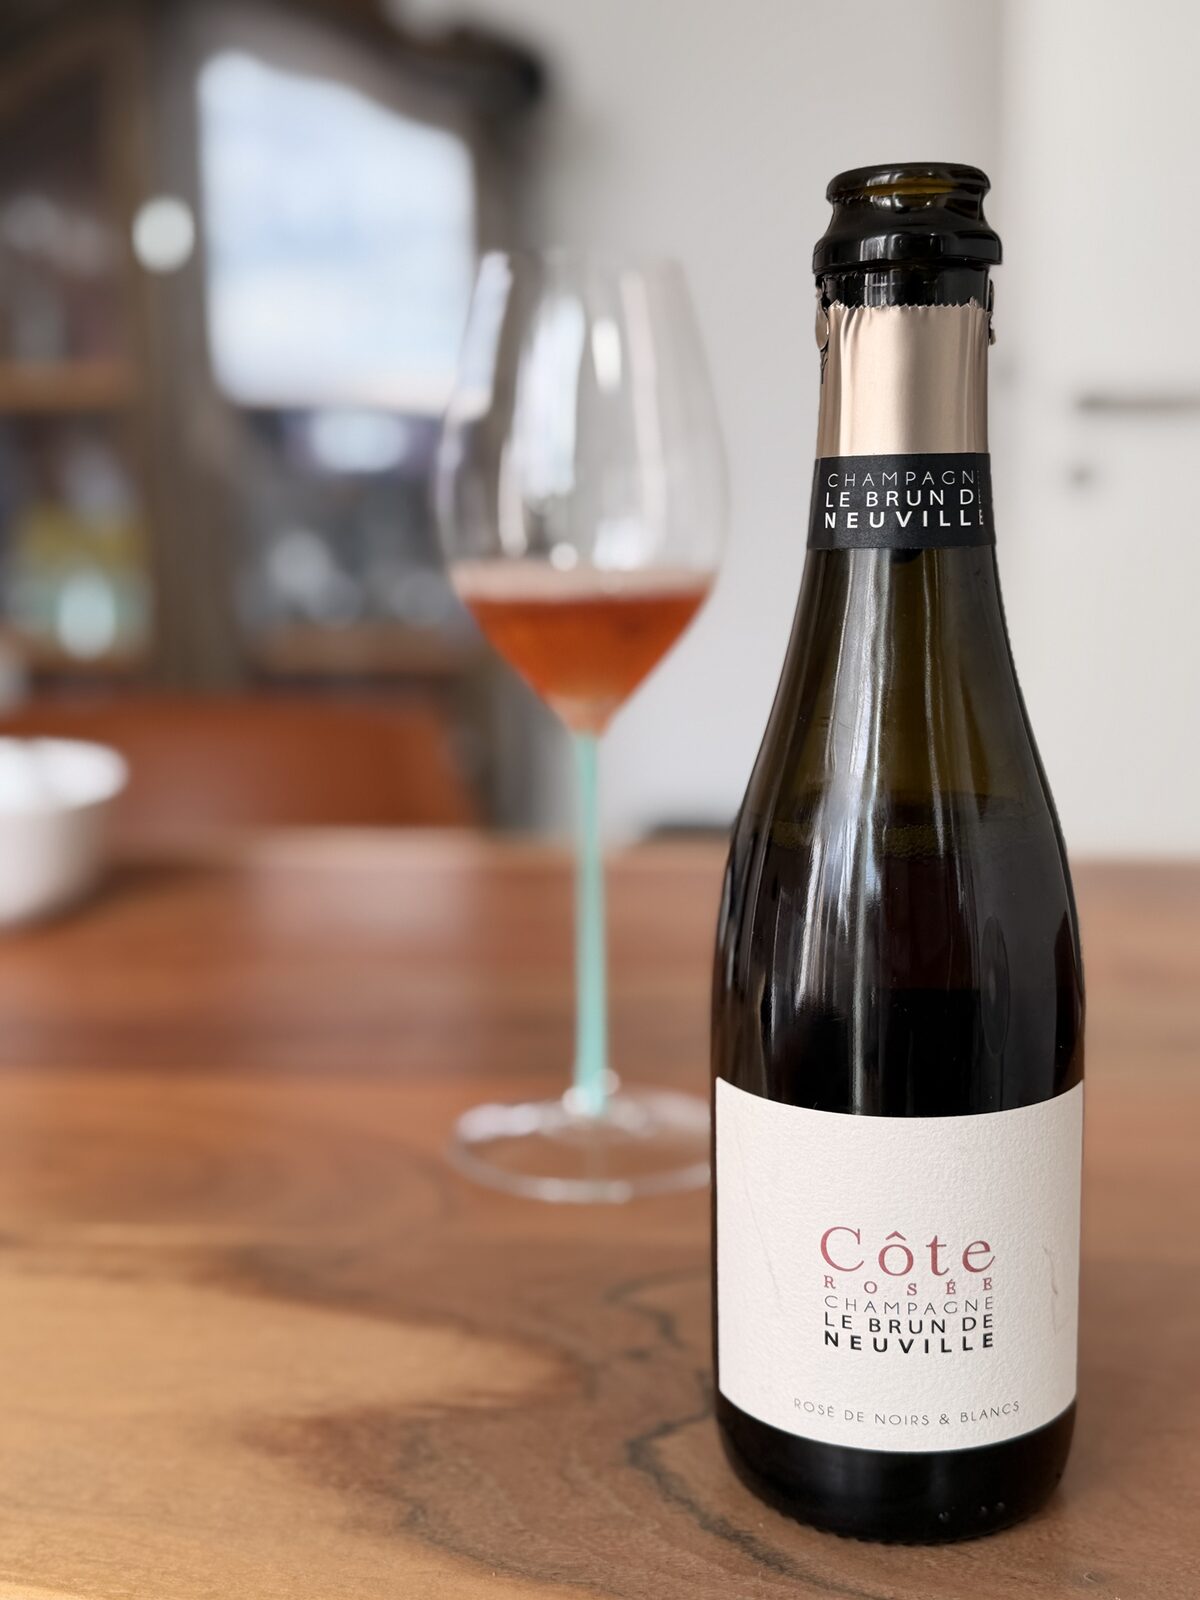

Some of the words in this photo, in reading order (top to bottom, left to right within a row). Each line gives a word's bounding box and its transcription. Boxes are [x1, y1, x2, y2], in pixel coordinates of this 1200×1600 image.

[827, 470, 982, 488] CHAMPAGN
[826, 491, 850, 508] LE
[866, 489, 944, 507] BRUN
[959, 487, 982, 505] D
[820, 1226, 996, 1276] Côte
[823, 1274, 993, 1296] ROSÉE
[824, 1295, 993, 1315] CHAMPAGNE
[825, 1311, 852, 1330] LE
[869, 1317, 946, 1335] BRUN
[962, 1313, 993, 1332] DE
[824, 1330, 993, 1354] NEUVILLE
[793, 1397, 835, 1418] ROSÉ
[844, 1409, 865, 1422] DE
[874, 1413, 930, 1426] NOIRS
[938, 1412, 950, 1425] &
[959, 1400, 1020, 1423] BLANCS
